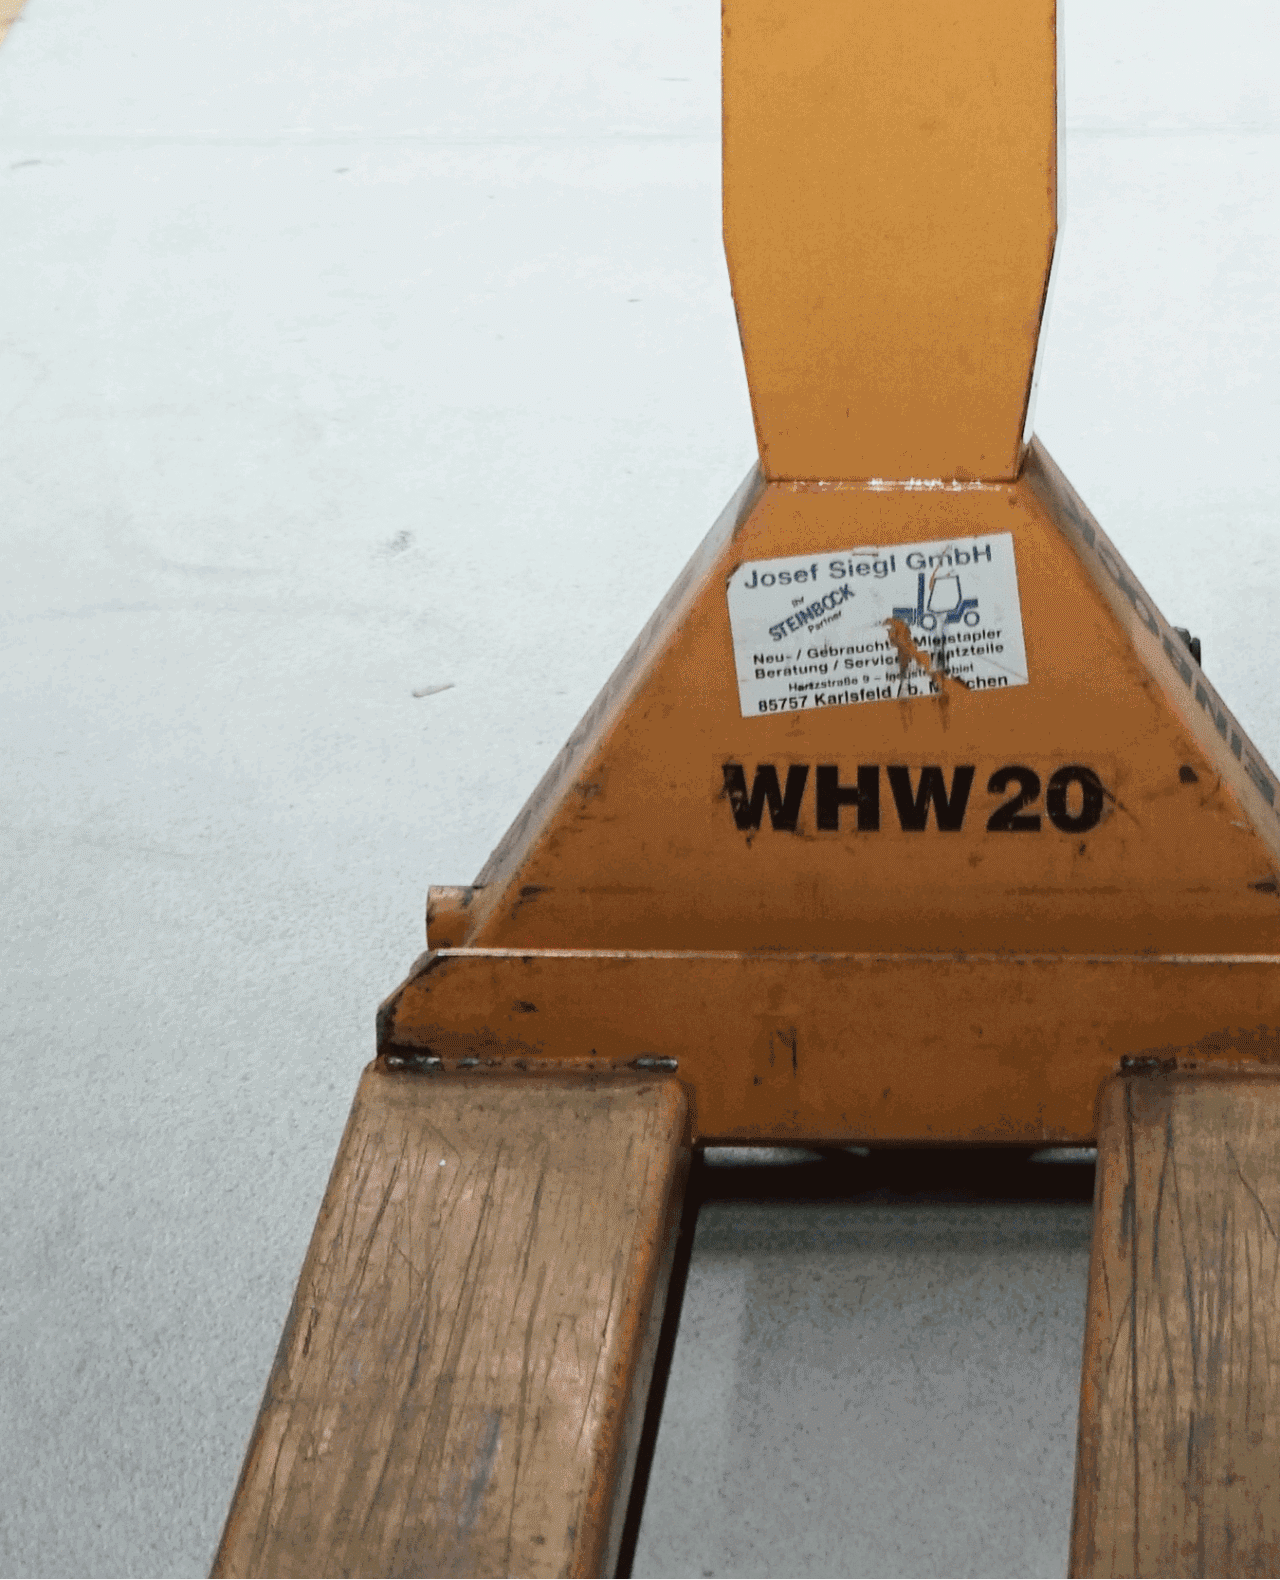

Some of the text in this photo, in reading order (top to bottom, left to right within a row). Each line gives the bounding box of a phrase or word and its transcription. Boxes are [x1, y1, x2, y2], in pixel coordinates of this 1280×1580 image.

[744, 544, 992, 589] Josef Siegl GmbH
[769, 583, 856, 642] STEINBOCK
[808, 610, 842, 634] Partner
[755, 662, 828, 680] Beratung
[758, 695, 808, 713] 85757
[814, 686, 892, 706] Karlsfeld
[929, 676, 1008, 696] Mchen
